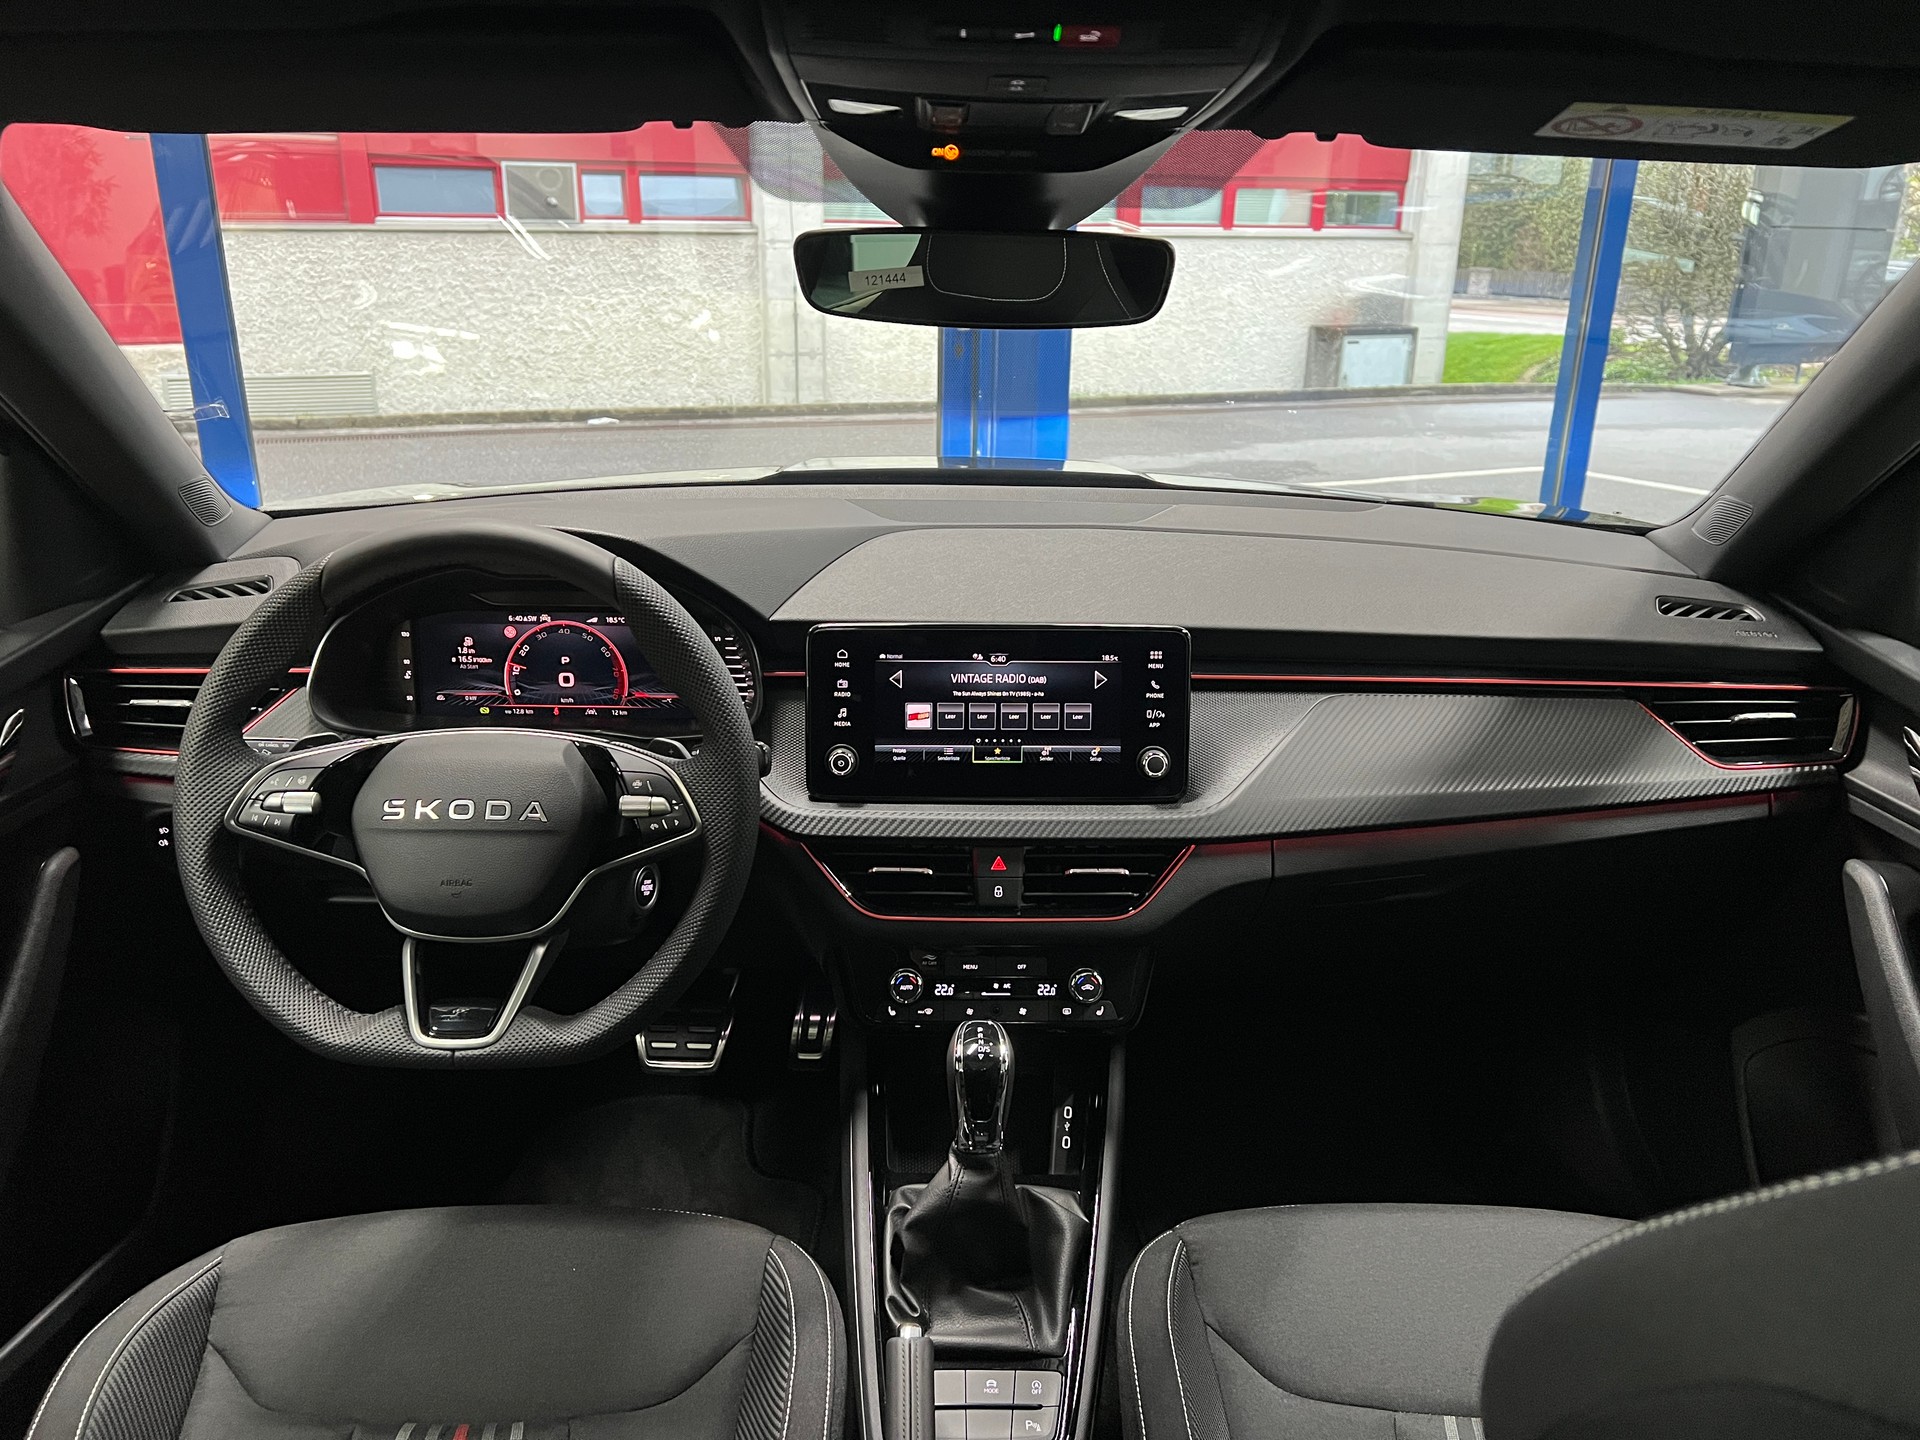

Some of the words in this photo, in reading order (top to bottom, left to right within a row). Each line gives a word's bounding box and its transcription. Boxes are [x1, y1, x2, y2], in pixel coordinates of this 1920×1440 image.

[864, 272, 906, 286] 121444
[536, 631, 548, 641] 30
[581, 632, 594, 642] 50
[519, 644, 530, 657] 20
[600, 646, 612, 658] 60
[561, 656, 570, 665] P
[990, 655, 1007, 663] 6:40
[512, 666, 521, 676] 10
[558, 672, 575, 688] 0
[950, 673, 993, 684] VINTAGE
[995, 673, 1026, 684] RADIO
[1027, 675, 1047, 685] (DAB)
[970, 690, 987, 698] Always
[440, 879, 473, 887] AIRBAG
[977, 1045, 991, 1053] D/S
